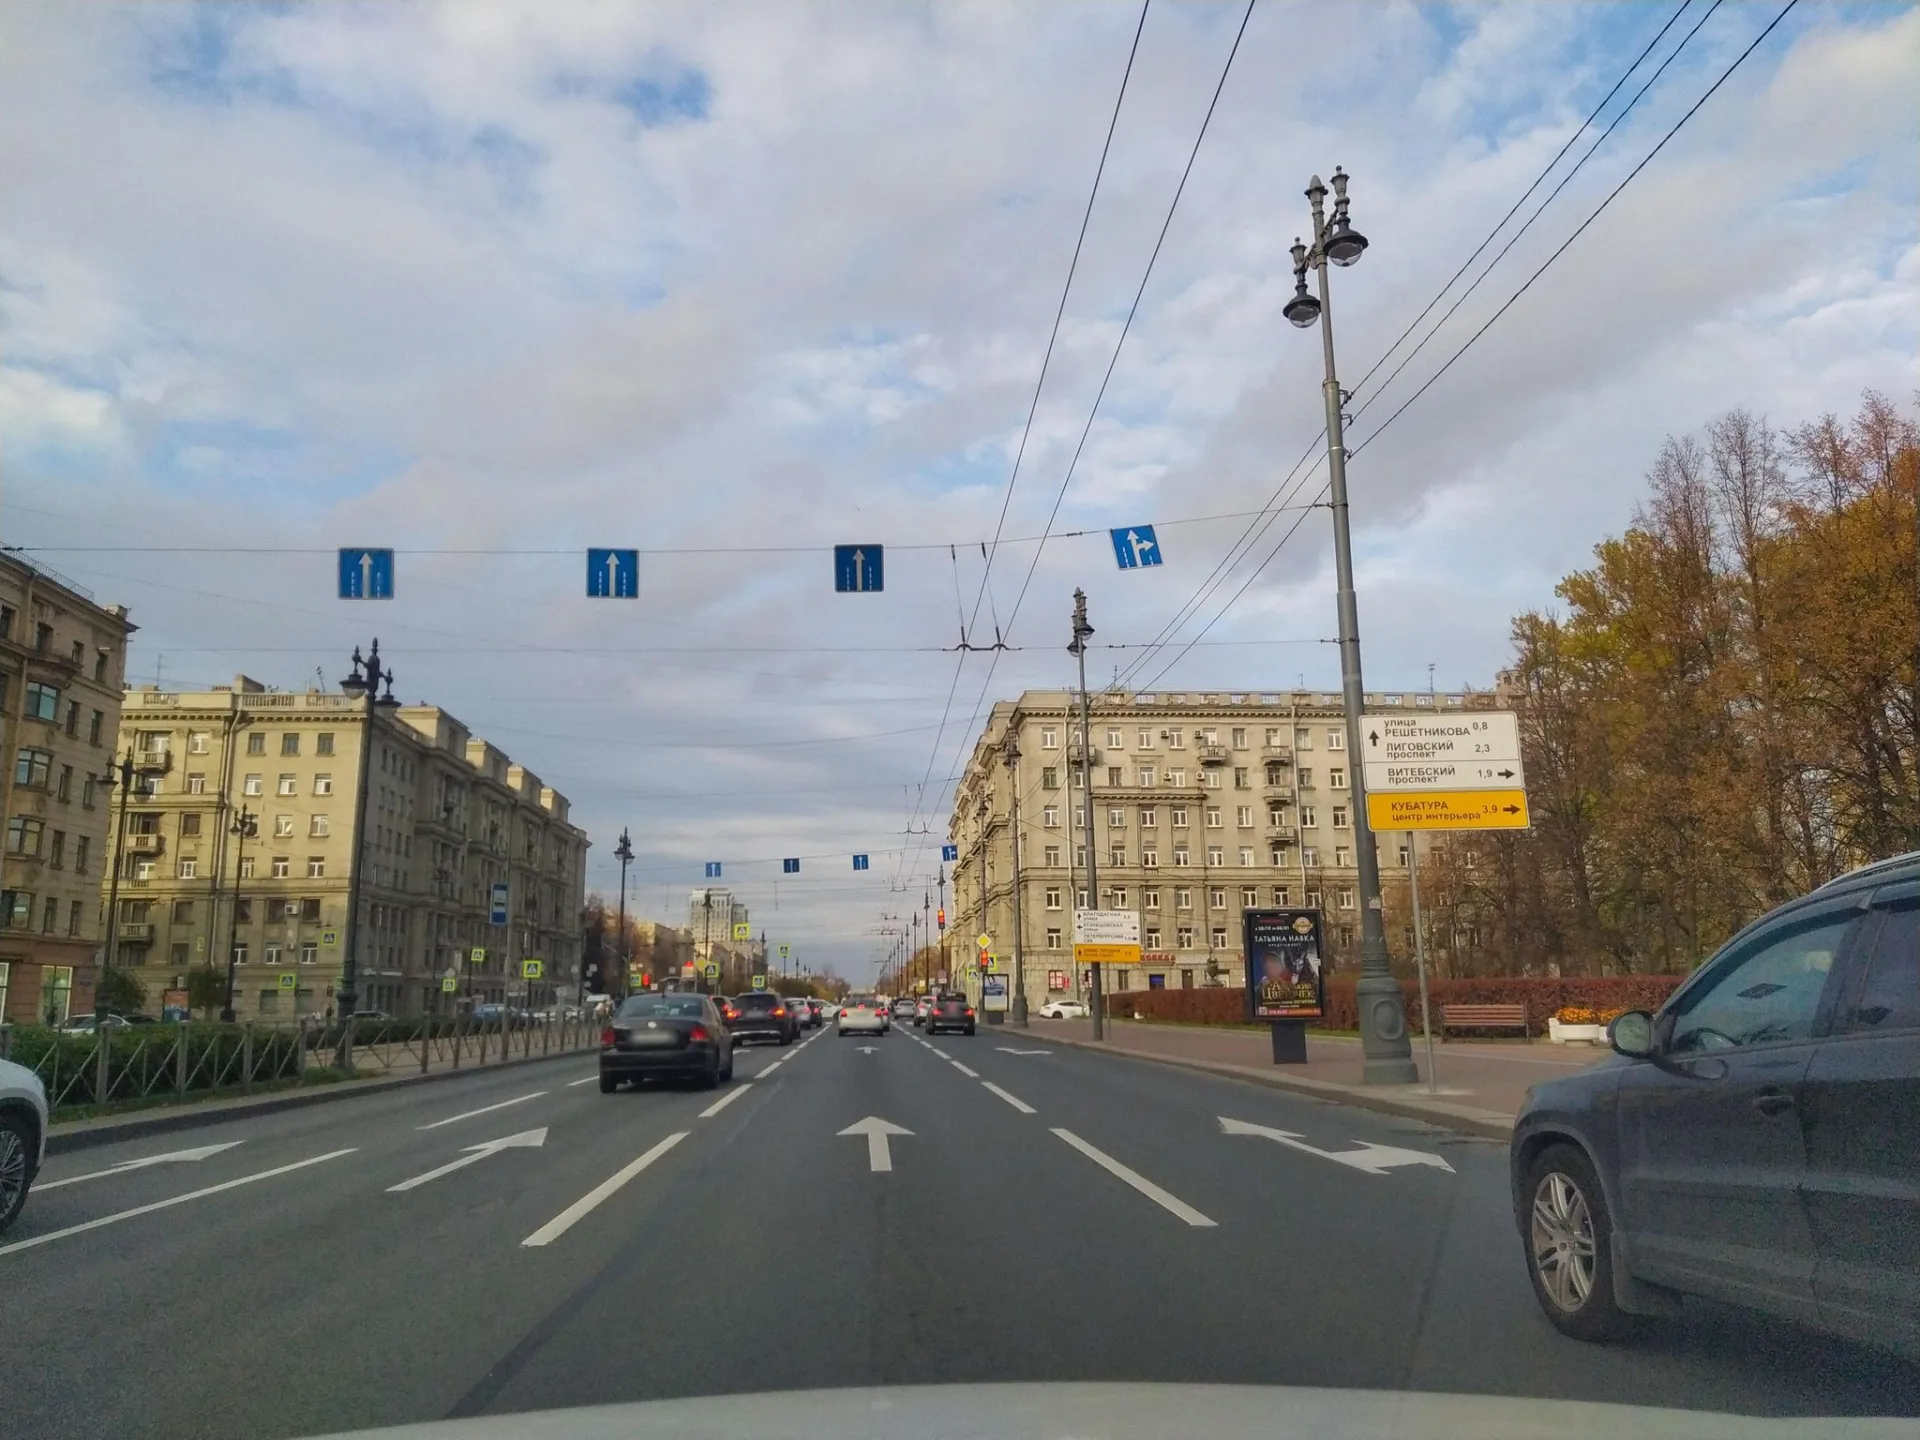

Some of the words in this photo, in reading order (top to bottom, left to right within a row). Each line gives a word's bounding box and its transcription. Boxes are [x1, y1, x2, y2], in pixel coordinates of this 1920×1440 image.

[1383, 719, 1416, 728] улица
[1472, 721, 1488, 731] 0,8
[1385, 727, 1470, 737] РЕШЕТНИКОВА
[1386, 740, 1454, 752] ЛИГОВСКИЙ
[1474, 744, 1491, 753] 2,3
[1387, 751, 1436, 760] проспект
[1388, 765, 1456, 777] ВИТЕБСКИЙ
[1478, 769, 1493, 779] 1,9
[1388, 776, 1438, 785] проспект
[1391, 801, 1449, 811] КУБАТУРА
[1482, 805, 1498, 815] 3,9
[1392, 813, 1423, 822] центр
[1425, 812, 1481, 822] интерьера
[1254, 935, 1287, 943] ТАТЬЯНА
[1288, 934, 1315, 942] НАВКА
